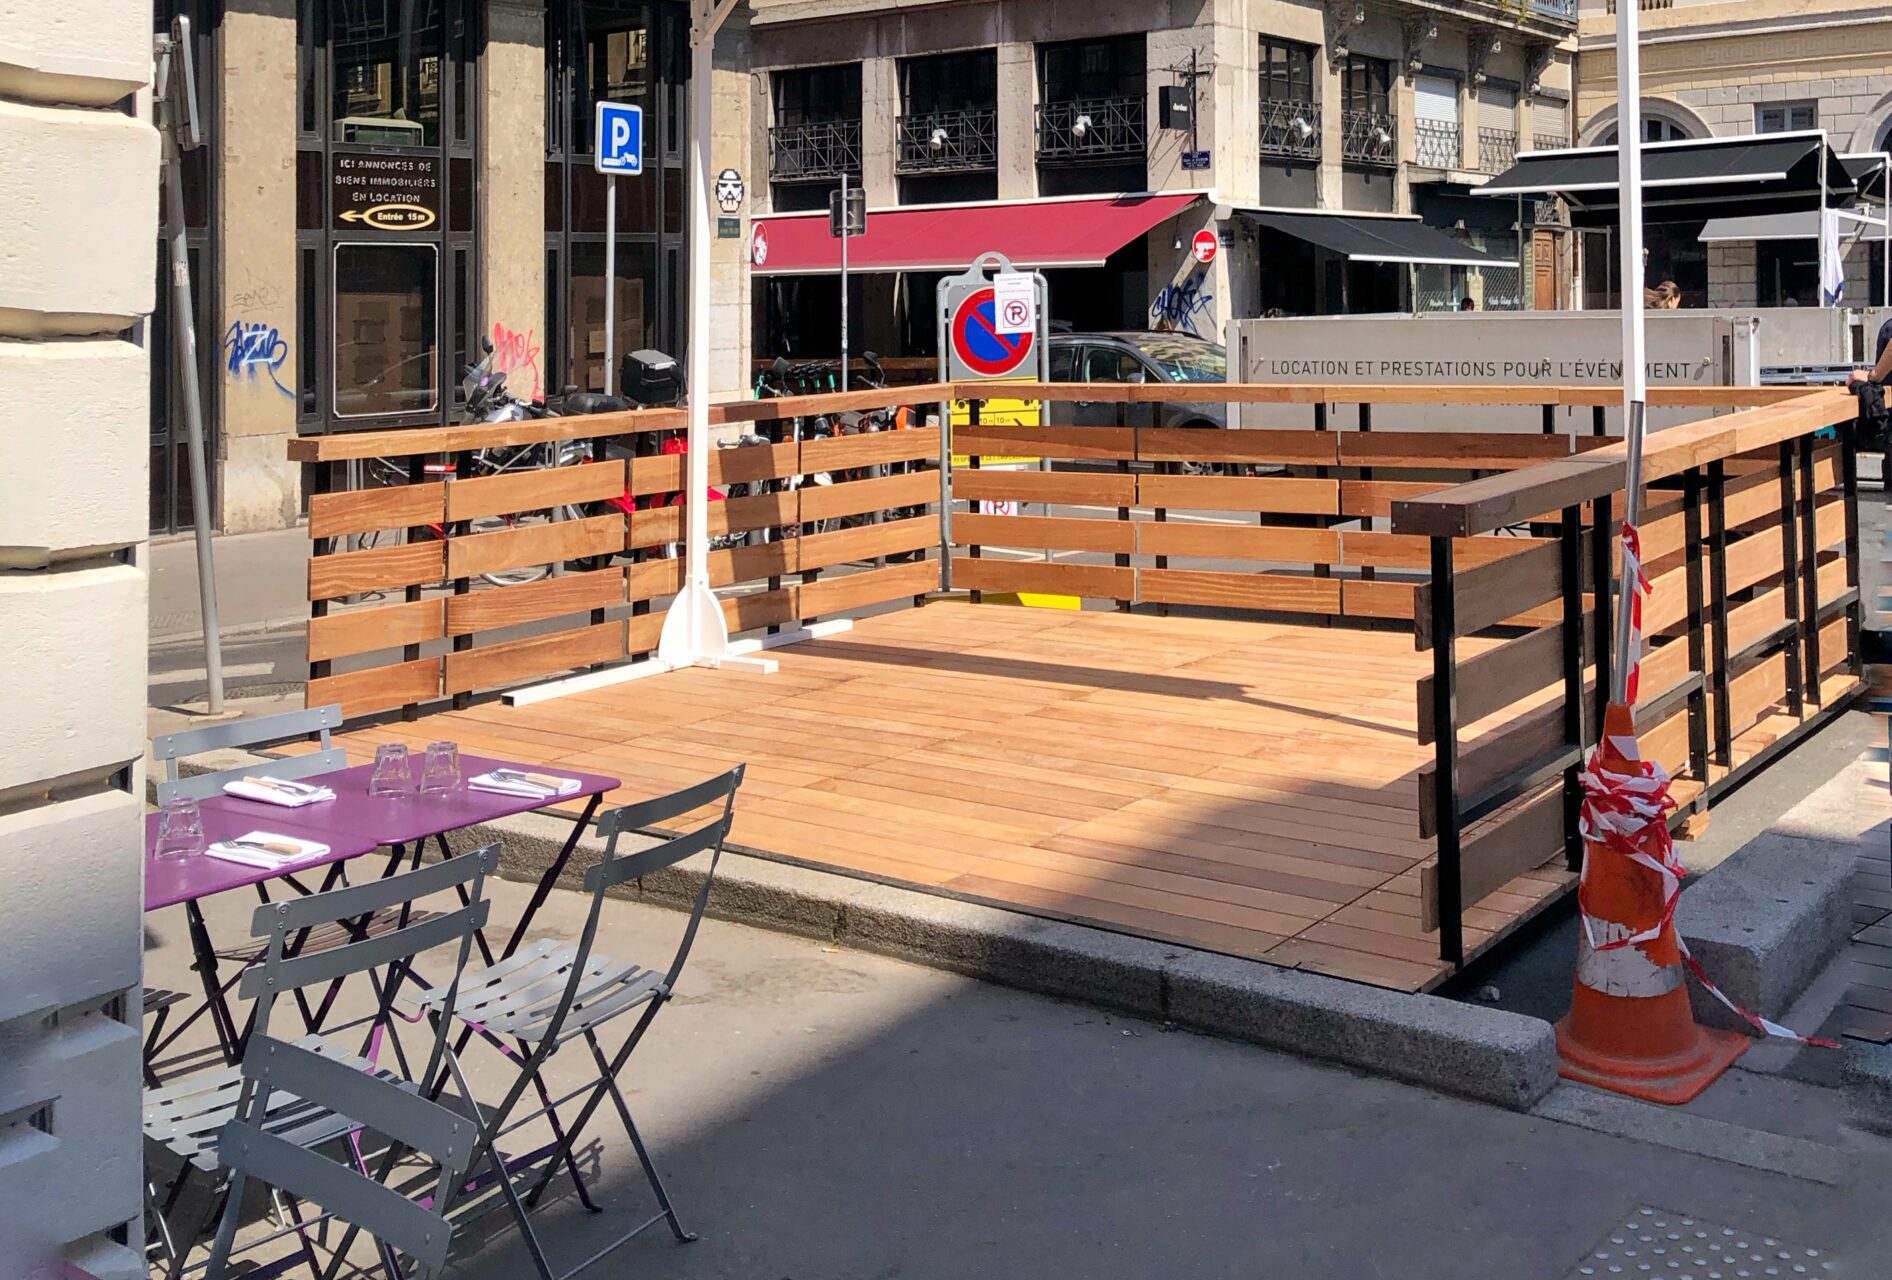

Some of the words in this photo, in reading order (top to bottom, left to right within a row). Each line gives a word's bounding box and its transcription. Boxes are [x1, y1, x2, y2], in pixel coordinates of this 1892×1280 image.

[612, 116, 631, 157] P
[340, 159, 355, 168] ICI
[358, 160, 414, 171] ANNONCES
[418, 162, 432, 172] DE
[335, 175, 367, 185] BIENS
[370, 177, 436, 188] IMMOBILIERS
[352, 192, 367, 202] EN
[369, 192, 420, 203] LOCATION
[377, 212, 404, 221] Entrée
[1271, 360, 1348, 375] LOCATION
[1355, 361, 1372, 376] ET
[1380, 361, 1496, 377] PRESTATIONS
[1503, 361, 1552, 378] POUR
